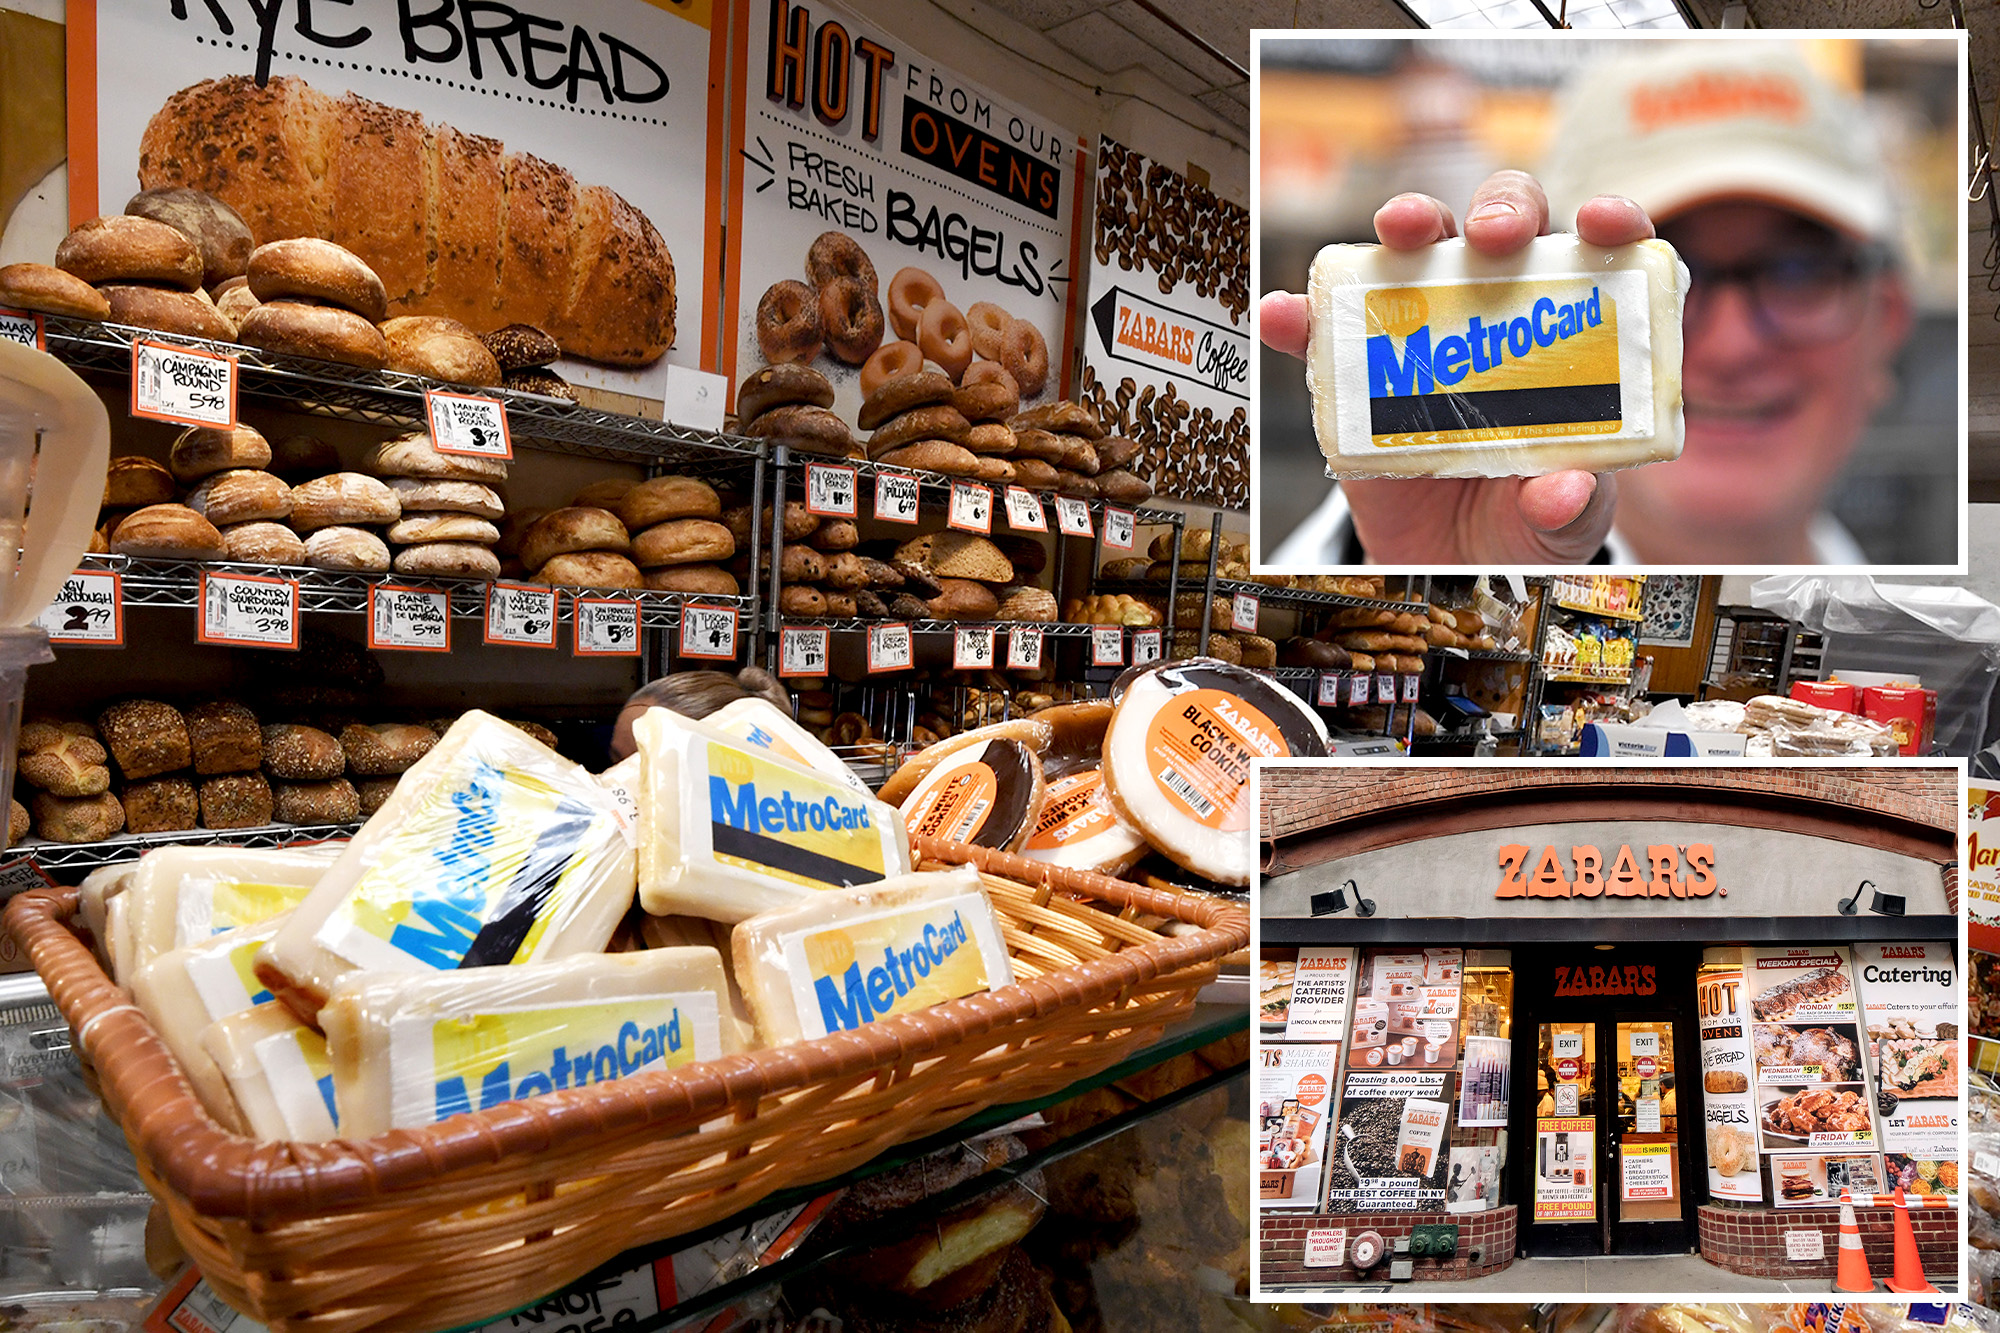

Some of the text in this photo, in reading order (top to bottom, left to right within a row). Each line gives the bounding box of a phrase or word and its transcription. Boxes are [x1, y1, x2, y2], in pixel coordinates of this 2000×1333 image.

[398, 0, 670, 104] BREAD
[766, 0, 894, 142] HOT
[905, 64, 1061, 163] FROM OUR
[910, 111, 1055, 209] OVENS
[787, 141, 875, 203] FRESH
[787, 178, 1045, 297] BAKED BAGELS
[1366, 286, 1603, 398] MetroCard
[1197, 331, 1247, 390] Coffee
[162, 358, 228, 382] CAMPAGNE
[173, 373, 221, 391] ROUND
[459, 417, 496, 428] ROUND
[1447, 423, 1617, 441] Insert this way This side facing you
[229, 593, 290, 607] SOURDOUGH
[234, 585, 290, 602] COUNTRY
[398, 594, 431, 605] PANE
[509, 596, 548, 606] WHOLE
[237, 603, 283, 617] LEVAIN
[509, 603, 550, 614] WHEAT
[699, 612, 732, 624] TUSCAN
[704, 620, 729, 630] LOAF
[1181, 703, 1237, 753] BLACK &
[1618, 741, 1644, 750] Victoria
[1189, 731, 1249, 786] COOKIES
[931, 773, 962, 814] WHITE
[708, 775, 870, 834] MetroCard
[1494, 843, 1718, 899] ZABAR'S
[1881, 946, 1925, 958] ZABAR'S
[814, 910, 968, 1034] MetroCard
[1300, 958, 1347, 971] ZABAR'S
[1554, 965, 1657, 997] ZABAR'S
[1864, 965, 1952, 987] Catering
[1427, 989, 1457, 997] ZABAR'S
[1700, 981, 1739, 1018] HOT
[1722, 1017, 1741, 1026] OUR
[1702, 1027, 1741, 1039] OVENS
[1560, 1040, 1577, 1048] EXIT
[1284, 1060, 1329, 1068] SHARING
[1715, 1051, 1745, 1065] BREAD
[1390, 1076, 1416, 1084] 8,000
[1347, 1088, 1440, 1097] of coffee every week
[1707, 1109, 1749, 1126] BAGELS
[1540, 1121, 1592, 1130] FREE COFFEE!
[1388, 1180, 1418, 1188] pound
[1358, 1200, 1416, 1208] Guaranteed.
